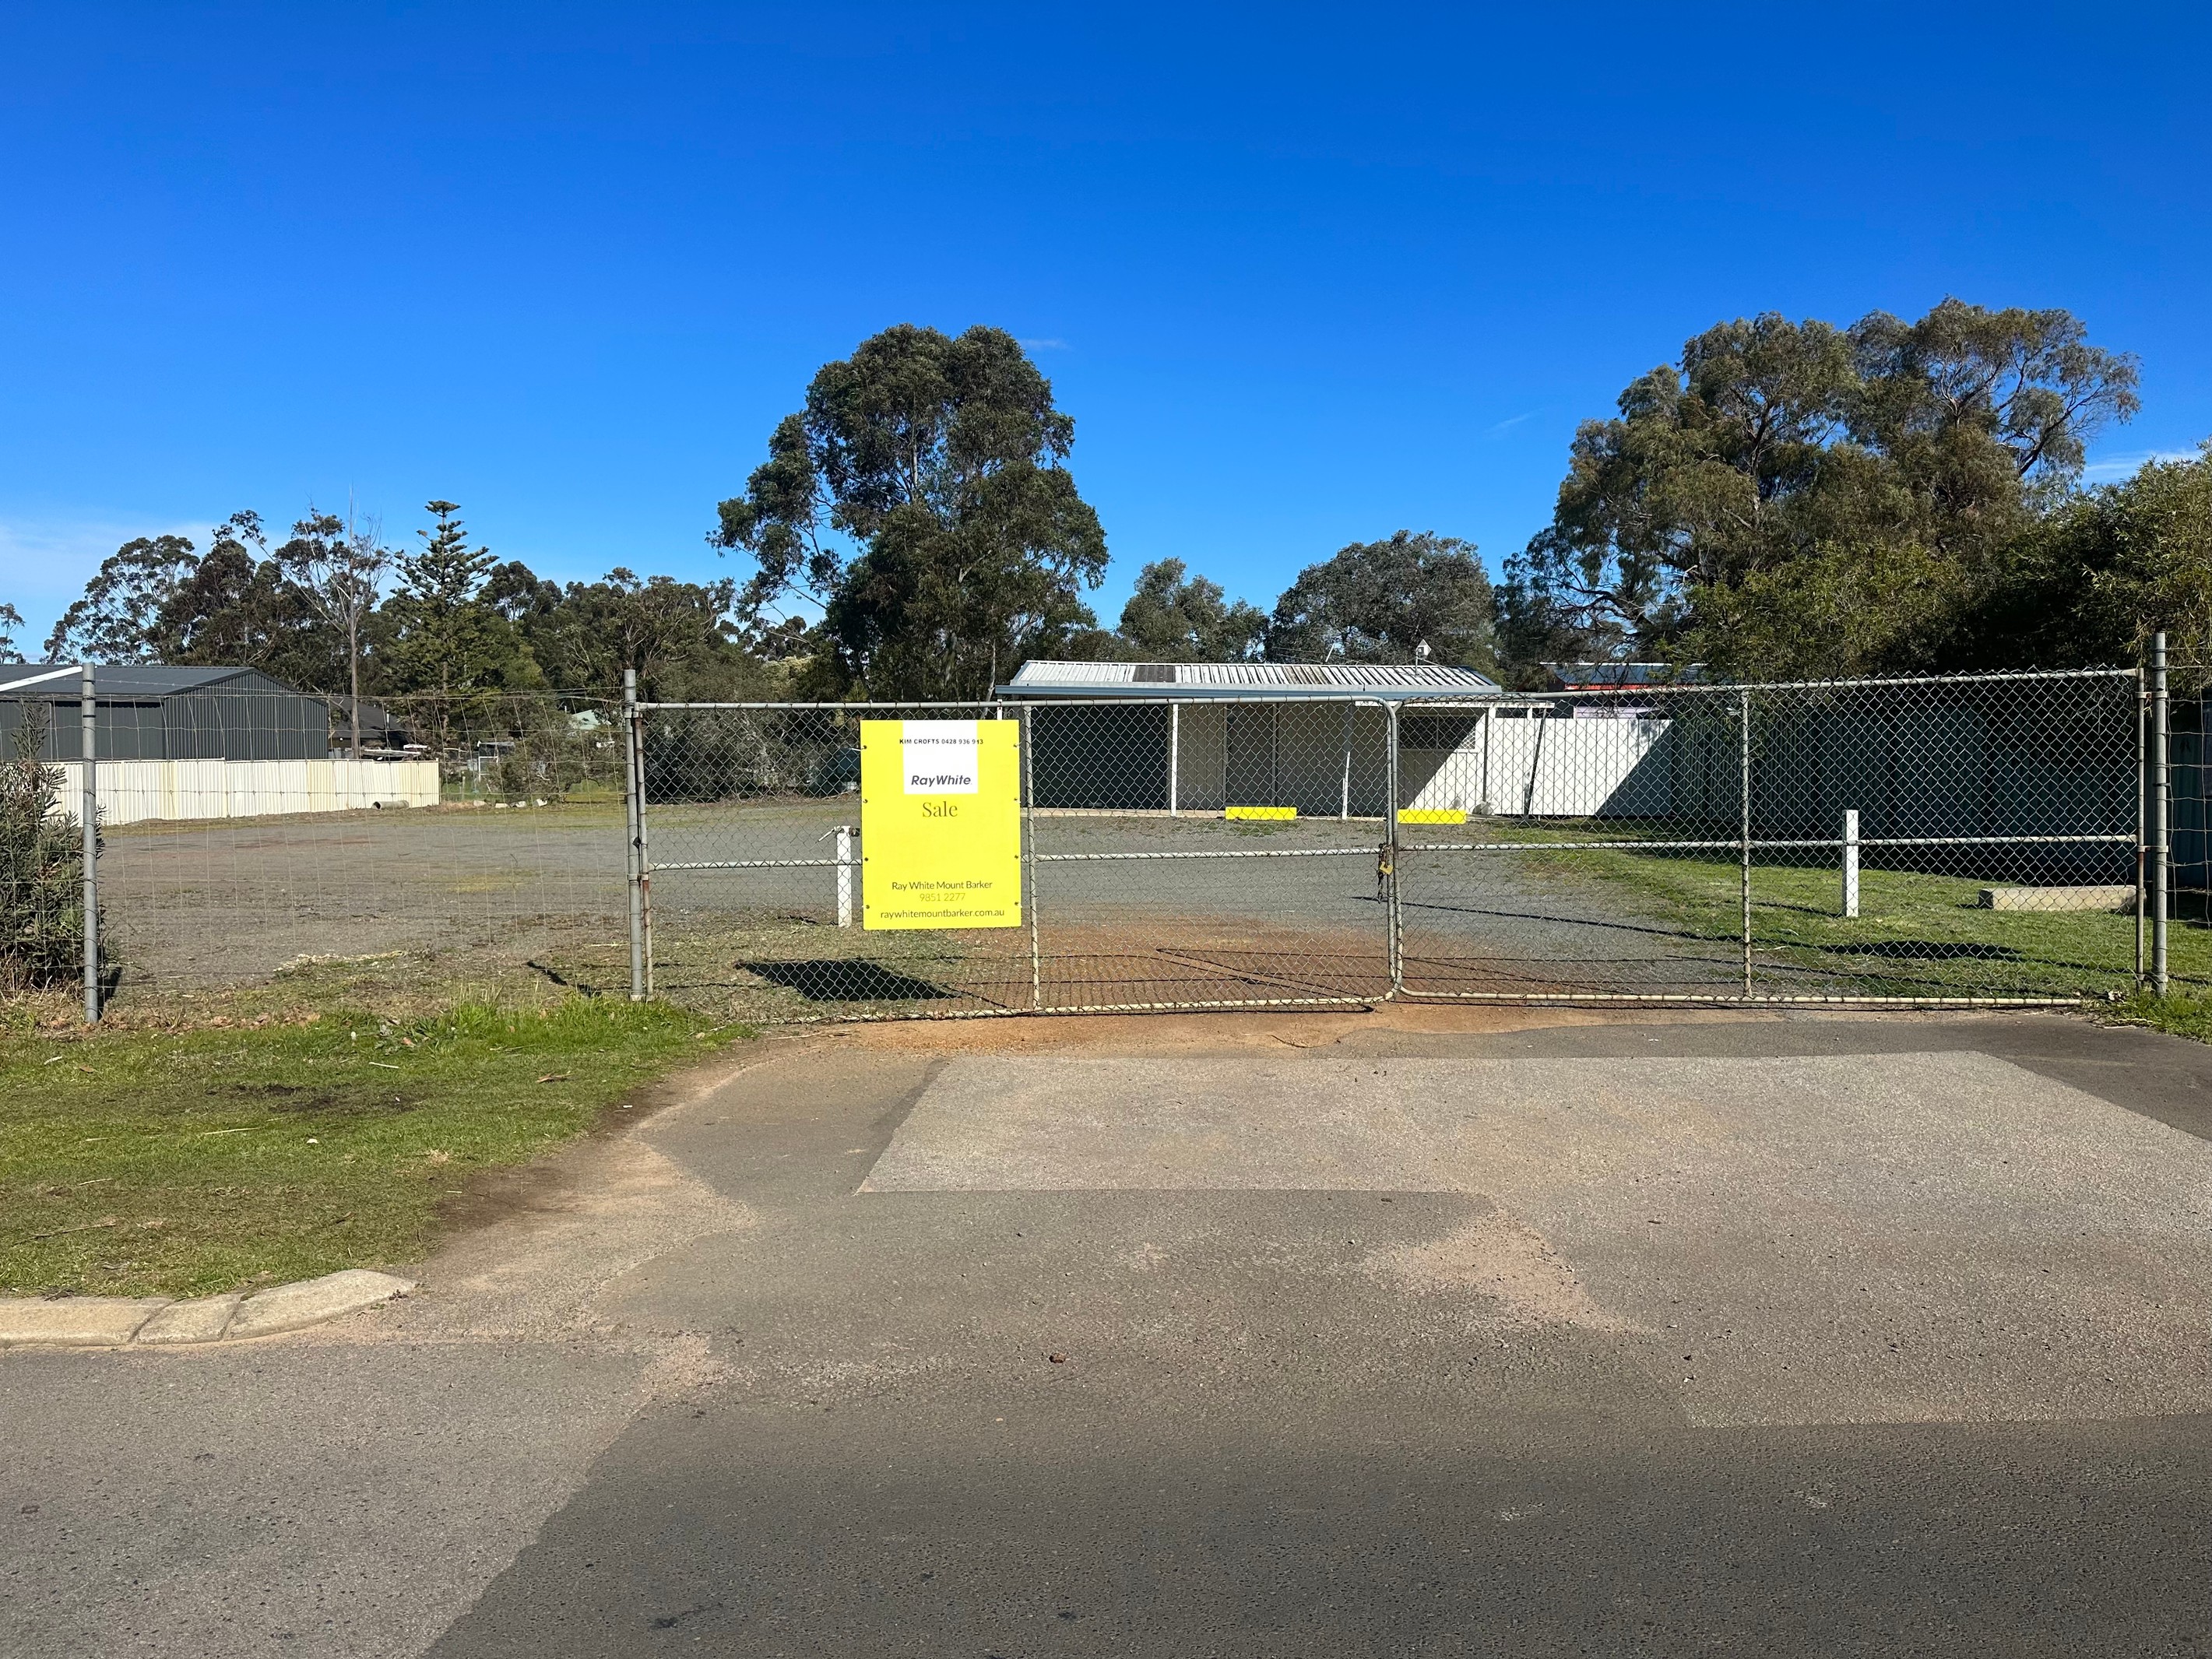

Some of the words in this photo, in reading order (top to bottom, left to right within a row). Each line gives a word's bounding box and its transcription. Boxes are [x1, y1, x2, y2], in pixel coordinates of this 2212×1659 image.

[922, 800, 958, 817] Sale
[891, 881, 908, 891] Ray
[909, 880, 935, 890] White
[936, 880, 964, 890] Mount
[966, 880, 993, 889] Barker
[920, 893, 941, 902] 9851
[944, 892, 965, 902] 2277
[881, 909, 1004, 920] raywhitemountbarker.com.au
